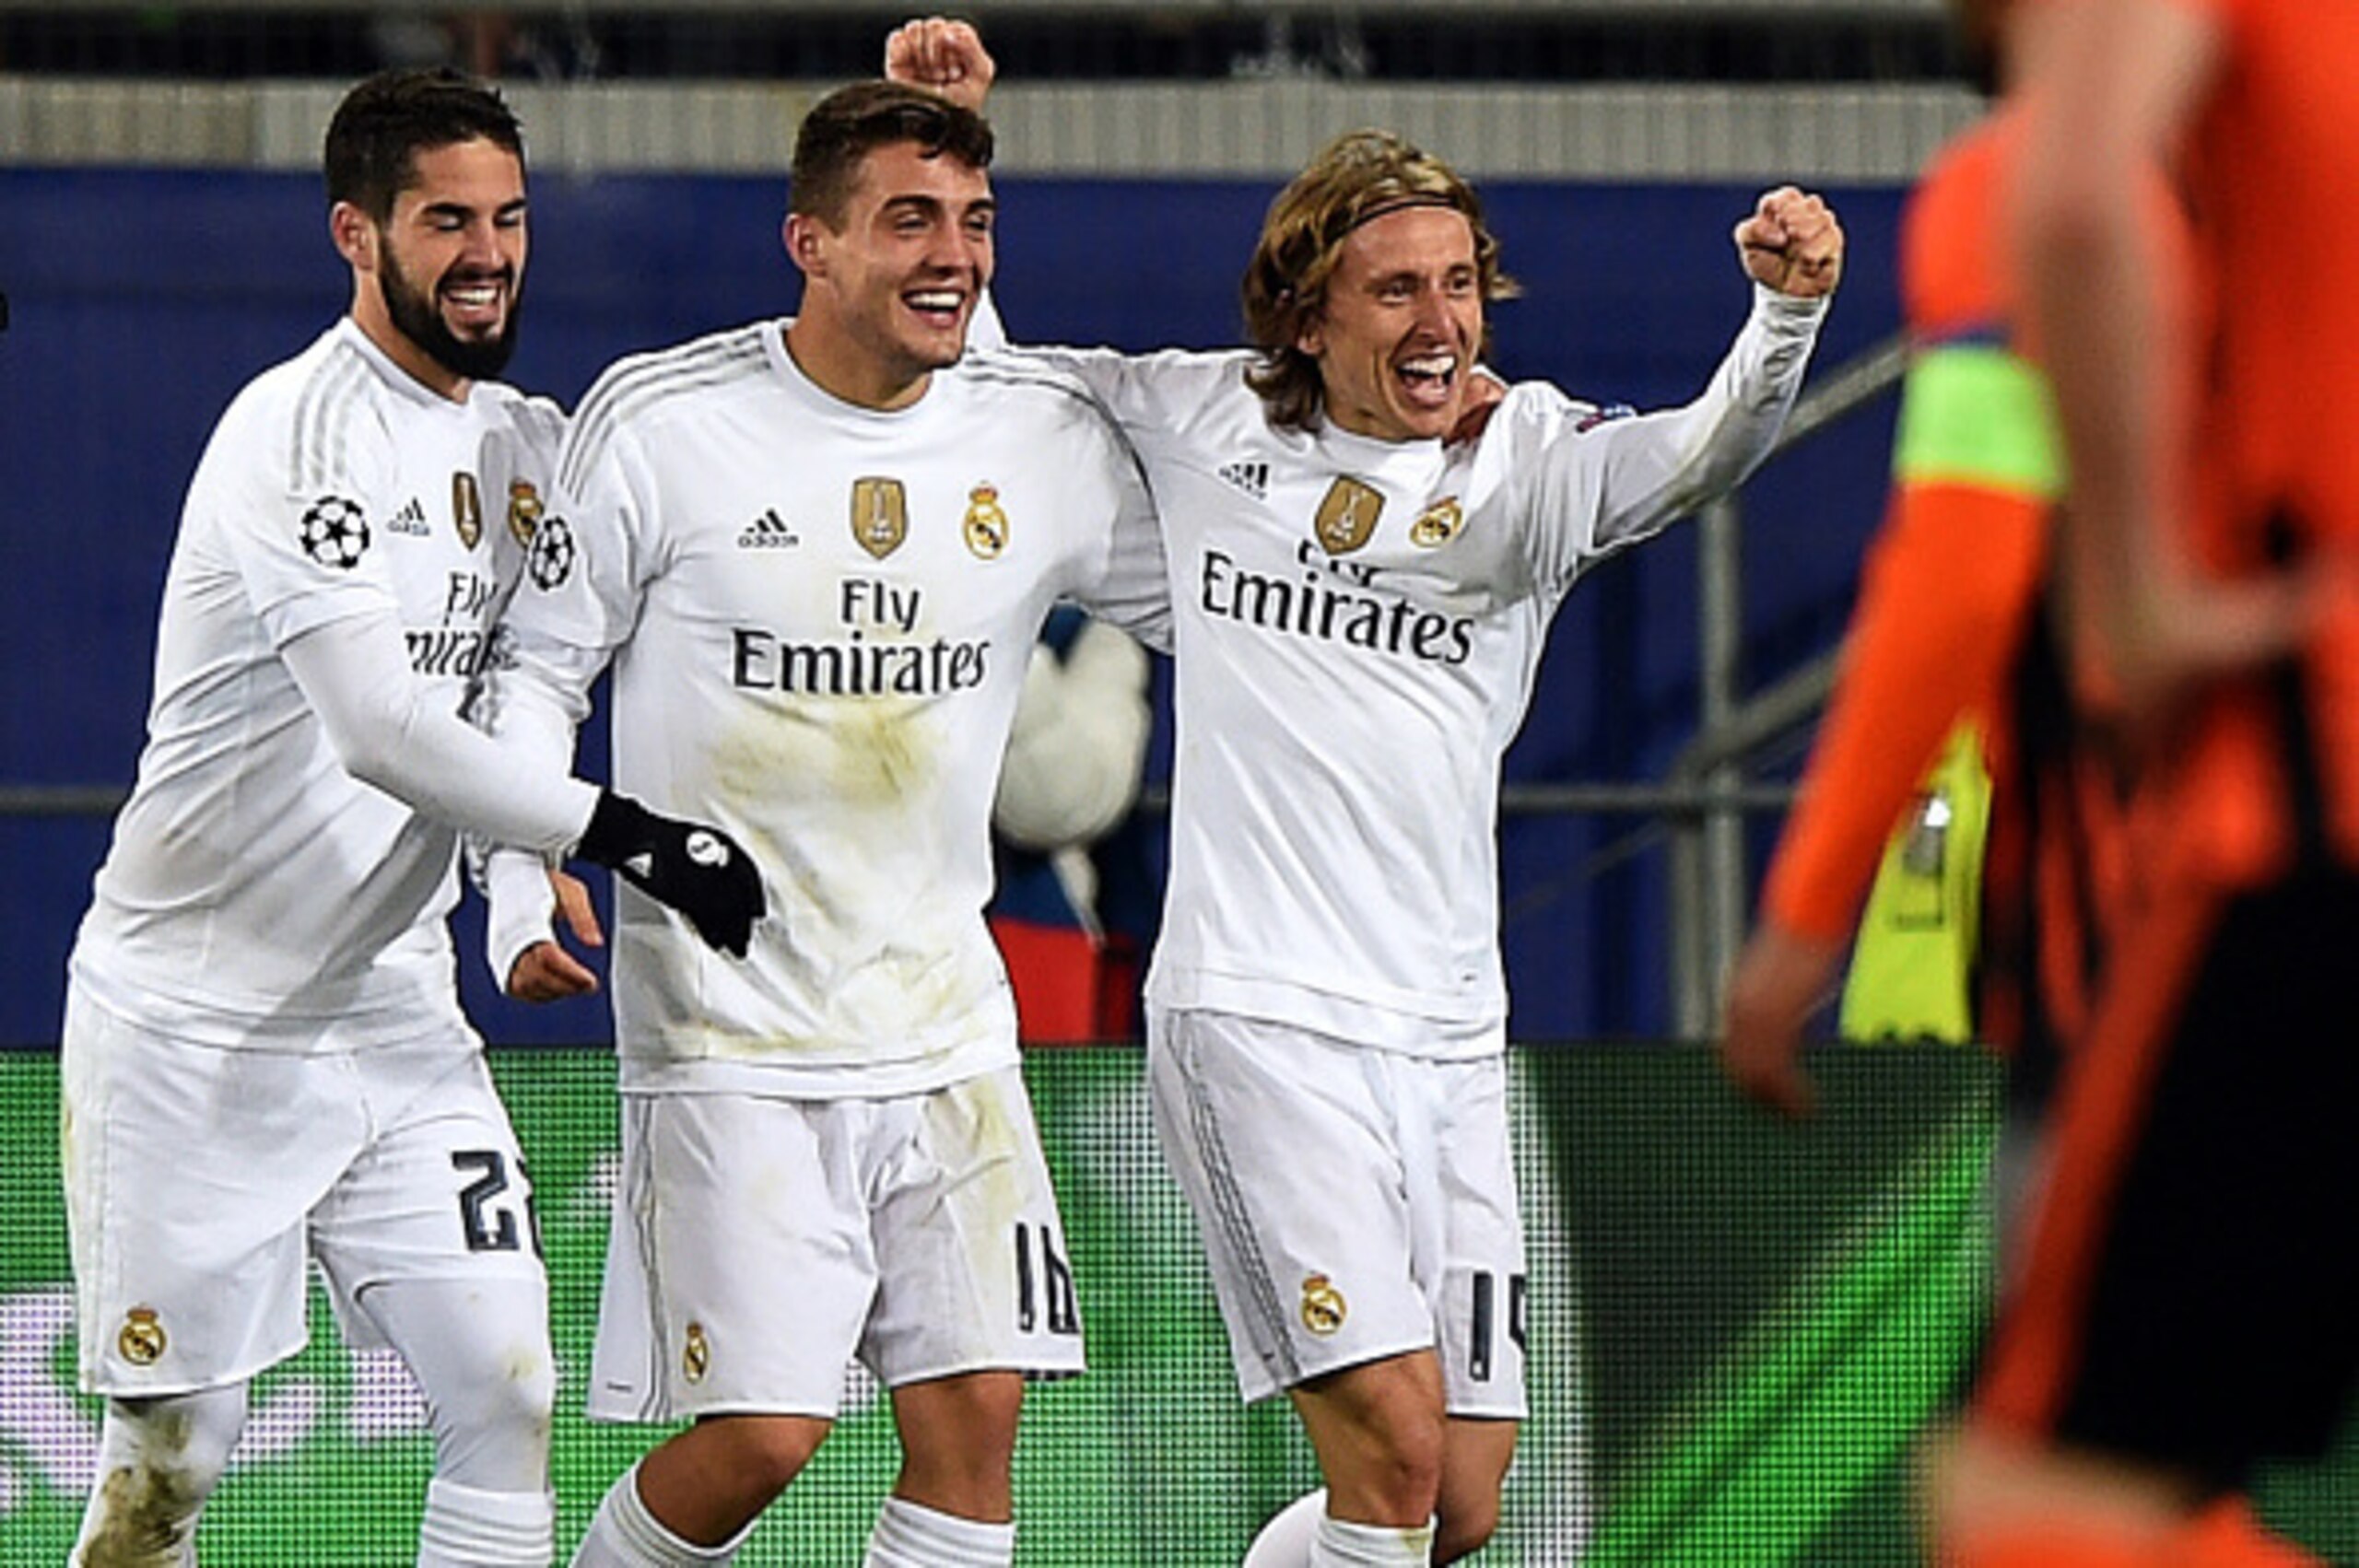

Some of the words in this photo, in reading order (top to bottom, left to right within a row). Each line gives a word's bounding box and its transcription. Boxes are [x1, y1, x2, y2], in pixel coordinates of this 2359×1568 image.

[841, 579, 921, 632] Fly
[1202, 550, 1474, 664] Emirates
[732, 627, 991, 696] Emirates
